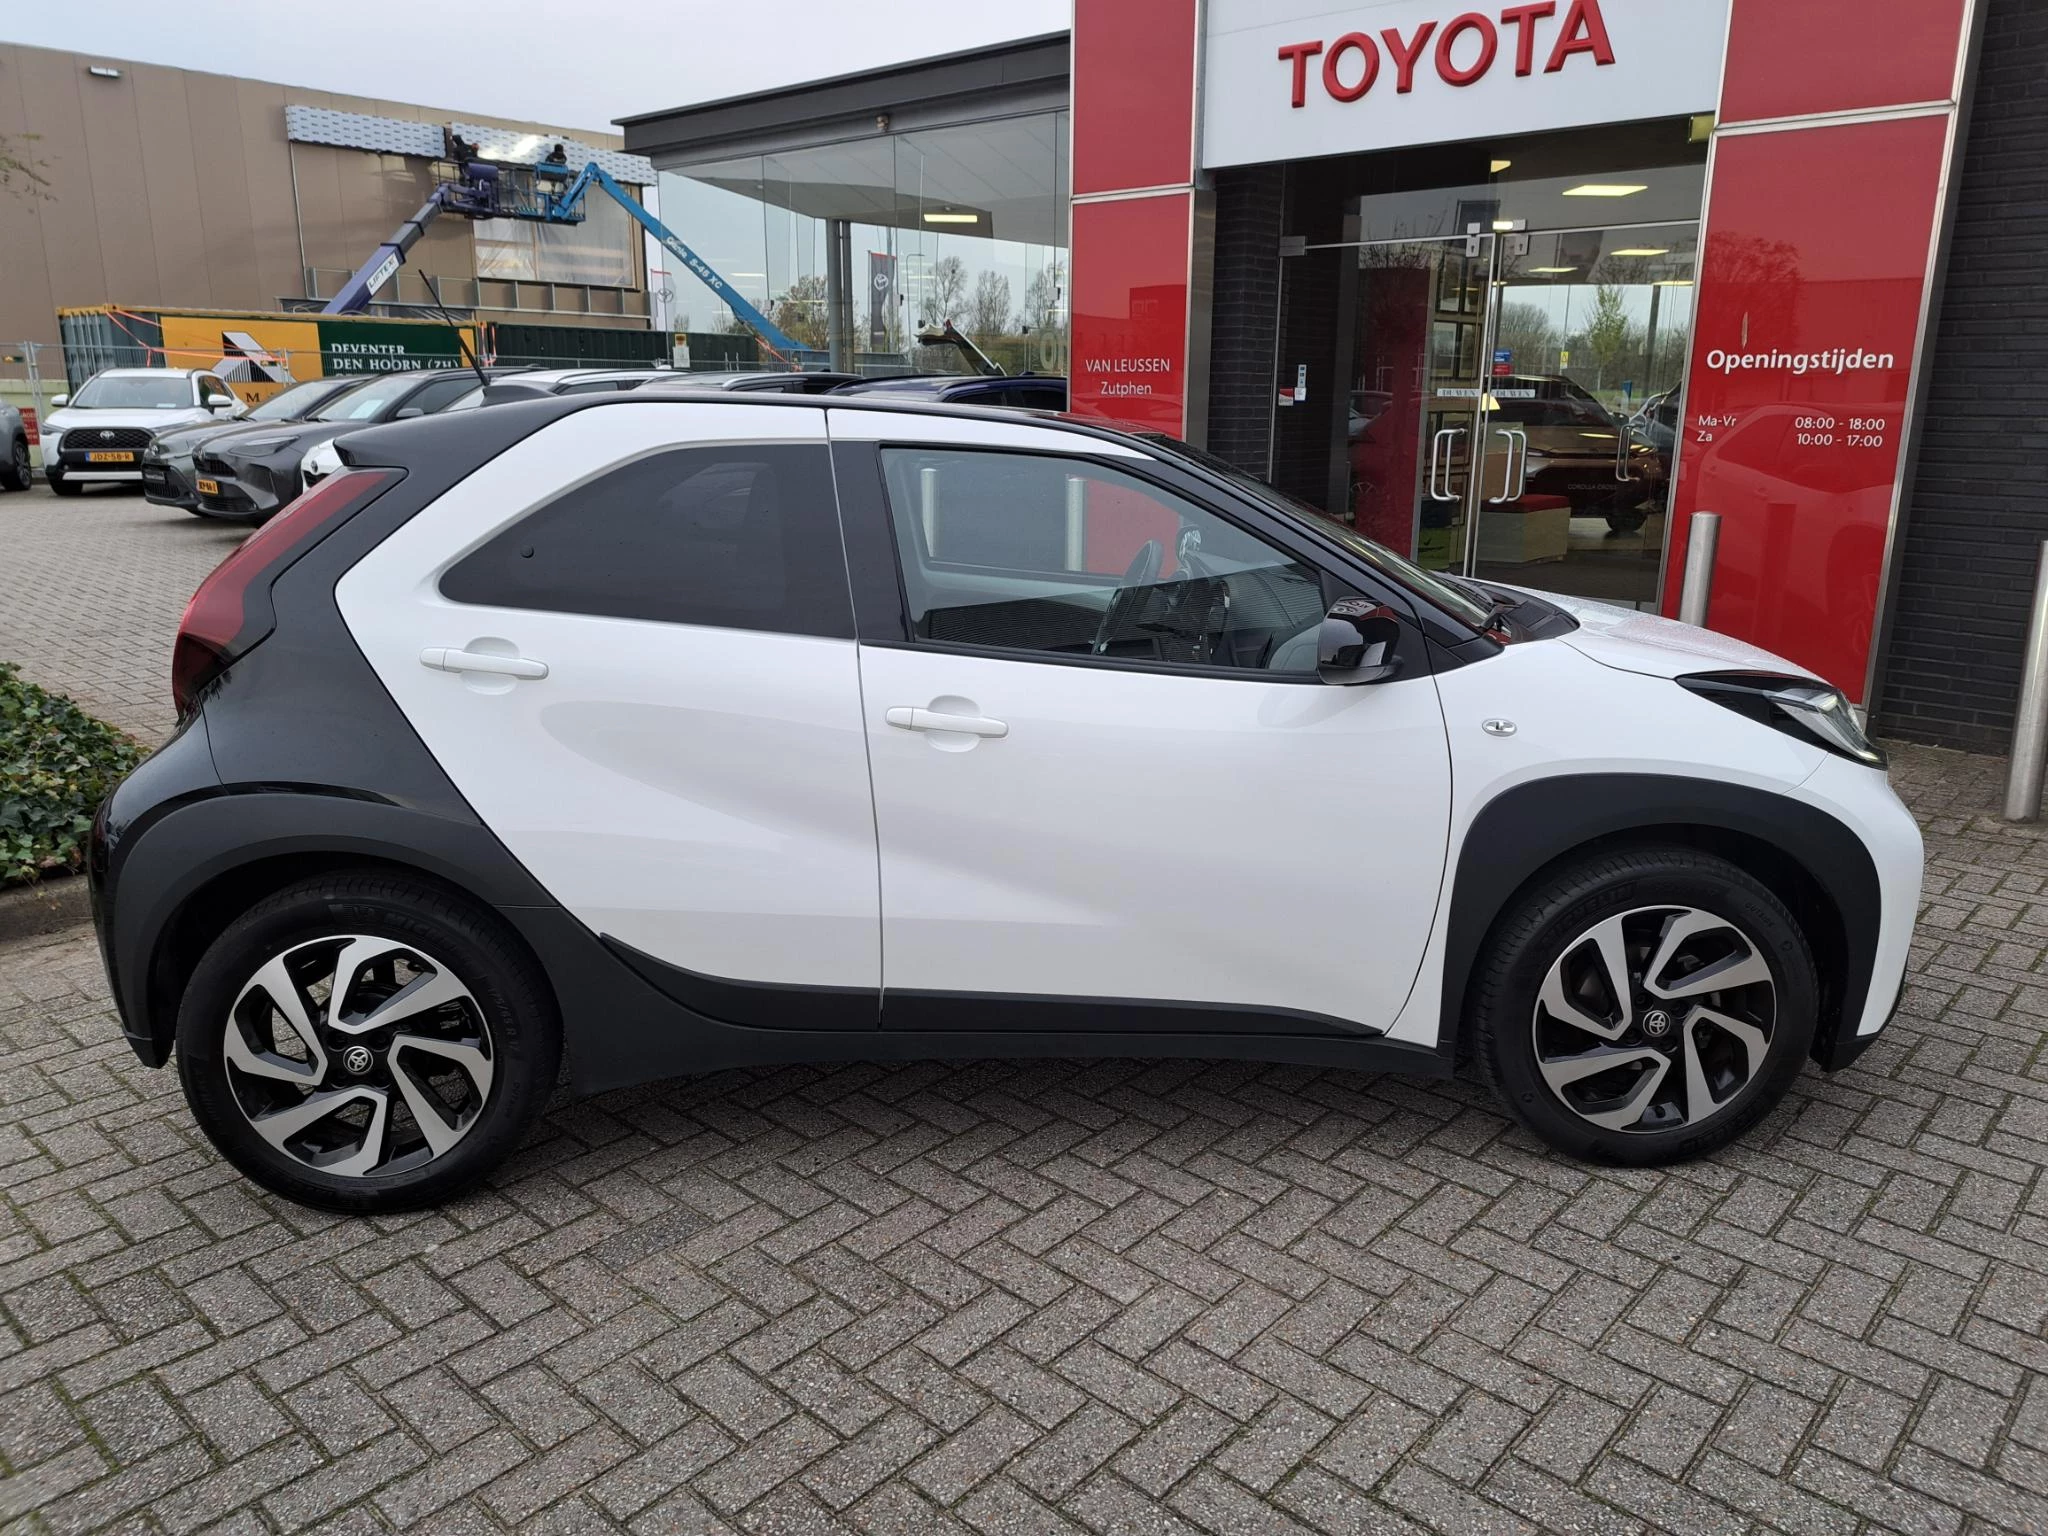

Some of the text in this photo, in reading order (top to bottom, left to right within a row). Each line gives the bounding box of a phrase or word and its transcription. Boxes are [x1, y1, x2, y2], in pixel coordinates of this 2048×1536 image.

[1278, 0, 1615, 108] TOYOTA
[708, 275, 723, 289] XC
[331, 342, 405, 355] DEVENTER
[333, 357, 363, 371] DEN
[369, 358, 421, 371] HOORN
[1085, 358, 1170, 372] VAN LEUSSEN
[1706, 347, 1894, 375] Openingstijden
[1100, 381, 1152, 398] Zutphen
[1698, 415, 1737, 426] Ma-Vr
[1794, 416, 1835, 429] 08:00
[1848, 417, 1885, 431] 18:00
[1696, 430, 1713, 442] Za
[1796, 432, 1833, 446] 10:00
[1846, 434, 1883, 448] 17:00
